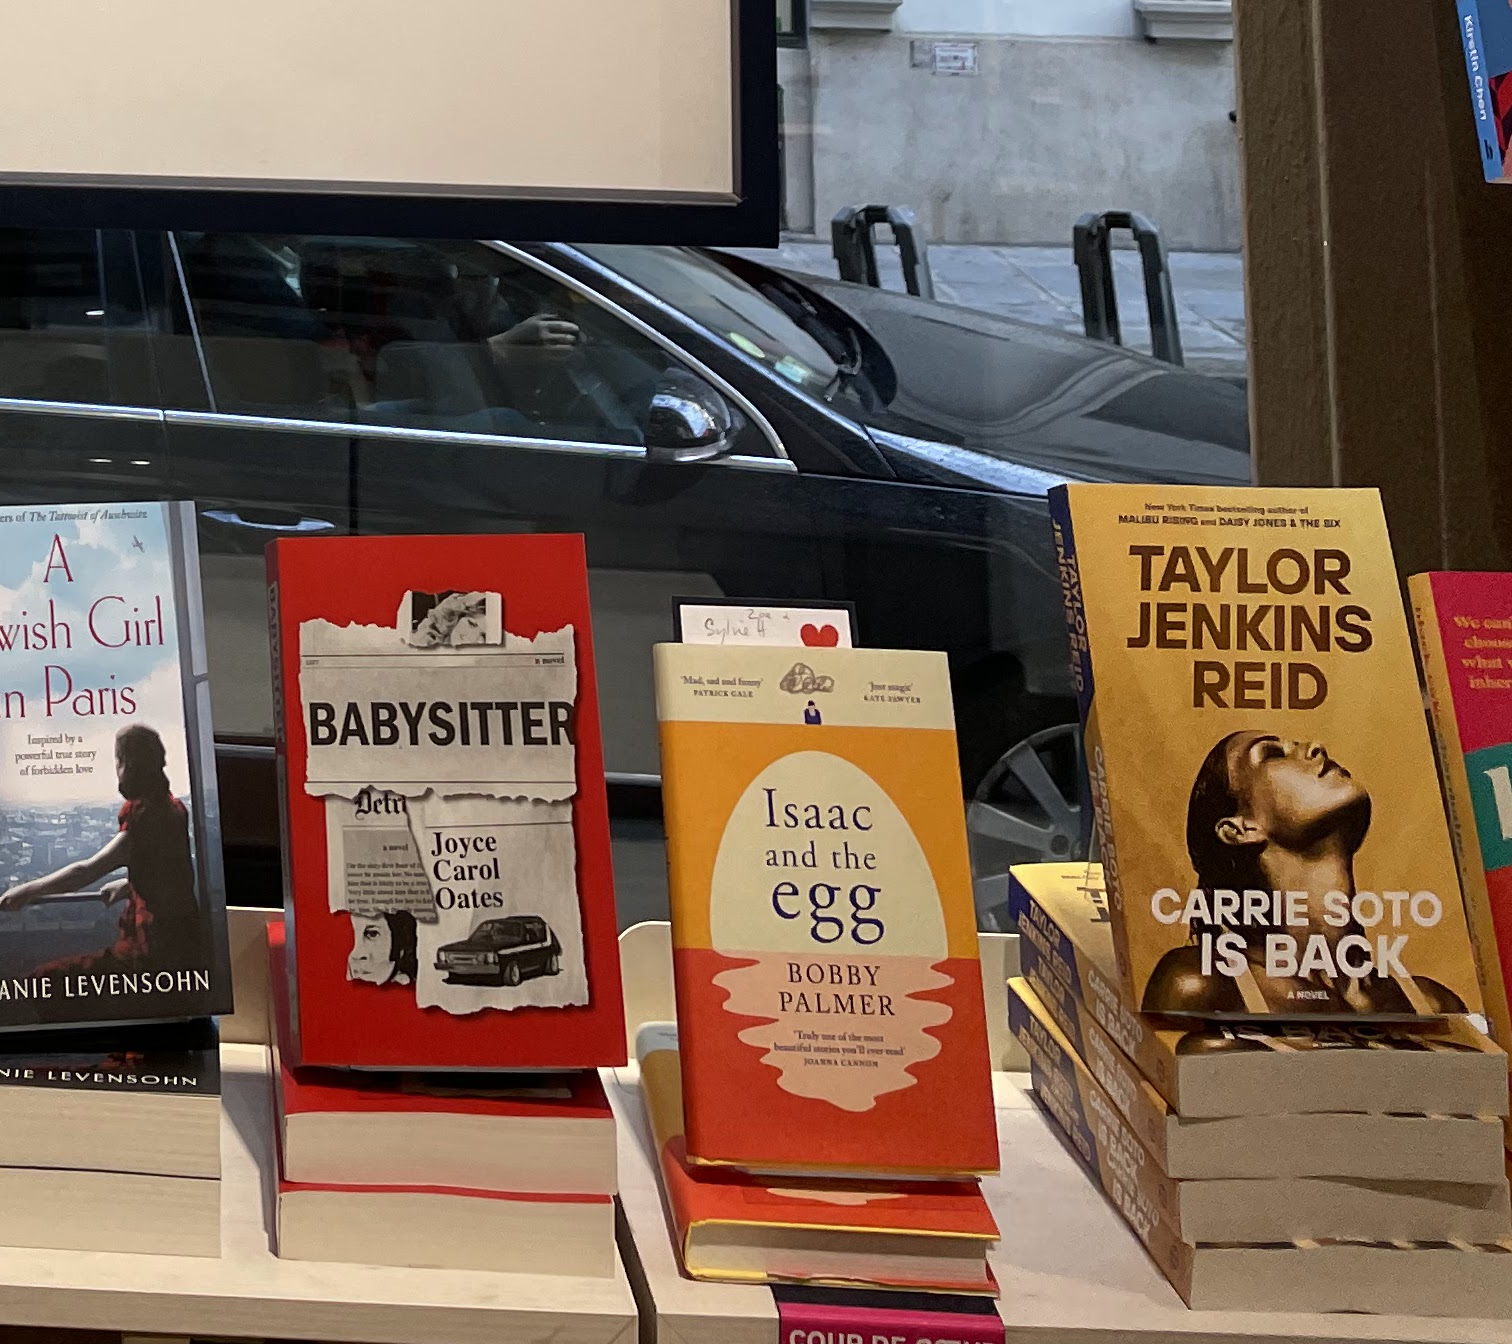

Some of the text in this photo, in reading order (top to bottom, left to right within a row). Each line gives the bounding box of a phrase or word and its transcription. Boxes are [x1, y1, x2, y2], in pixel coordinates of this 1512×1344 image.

[15, 510, 27, 522] of
[29, 510, 47, 522] The
[1118, 515, 1159, 525] MALIBU
[1219, 517, 1250, 528] DAISY
[1252, 518, 1286, 528] JONES
[1299, 519, 1320, 529] THE
[1323, 519, 1341, 529] SIX
[43, 532, 74, 583] A
[1128, 545, 1352, 596] TAYLOR
[1066, 554, 1088, 653] TAYLOR
[88, 595, 165, 648] Girl
[1126, 602, 1373, 653] JENKINS
[44, 664, 137, 718] Paris
[1192, 660, 1329, 711] REID
[308, 701, 575, 746] BABYSITTER
[27, 733, 63, 748] Inspired
[64, 732, 75, 747] by
[15, 748, 97, 765] powerful true story
[19, 763, 94, 776] of forbidden love
[762, 787, 874, 832] Isaac
[431, 831, 498, 858] Joyce
[765, 840, 877, 870] and the
[433, 858, 501, 882] Carol
[435, 886, 504, 910] Oates
[1150, 887, 1443, 928] CARRIE SOTO
[771, 880, 885, 946] egg
[1201, 933, 1412, 979] IS BACK
[64, 969, 211, 998] LEVENSOHN
[787, 962, 882, 987] BOBBY
[778, 990, 896, 1018] PALMER
[1297, 990, 1330, 1001] NOVEL
[773, 1042, 812, 1053] beautiful
[848, 1032, 862, 1042] the
[803, 1057, 839, 1068] JOANNA
[47, 1070, 198, 1087] LEVENSOHN
